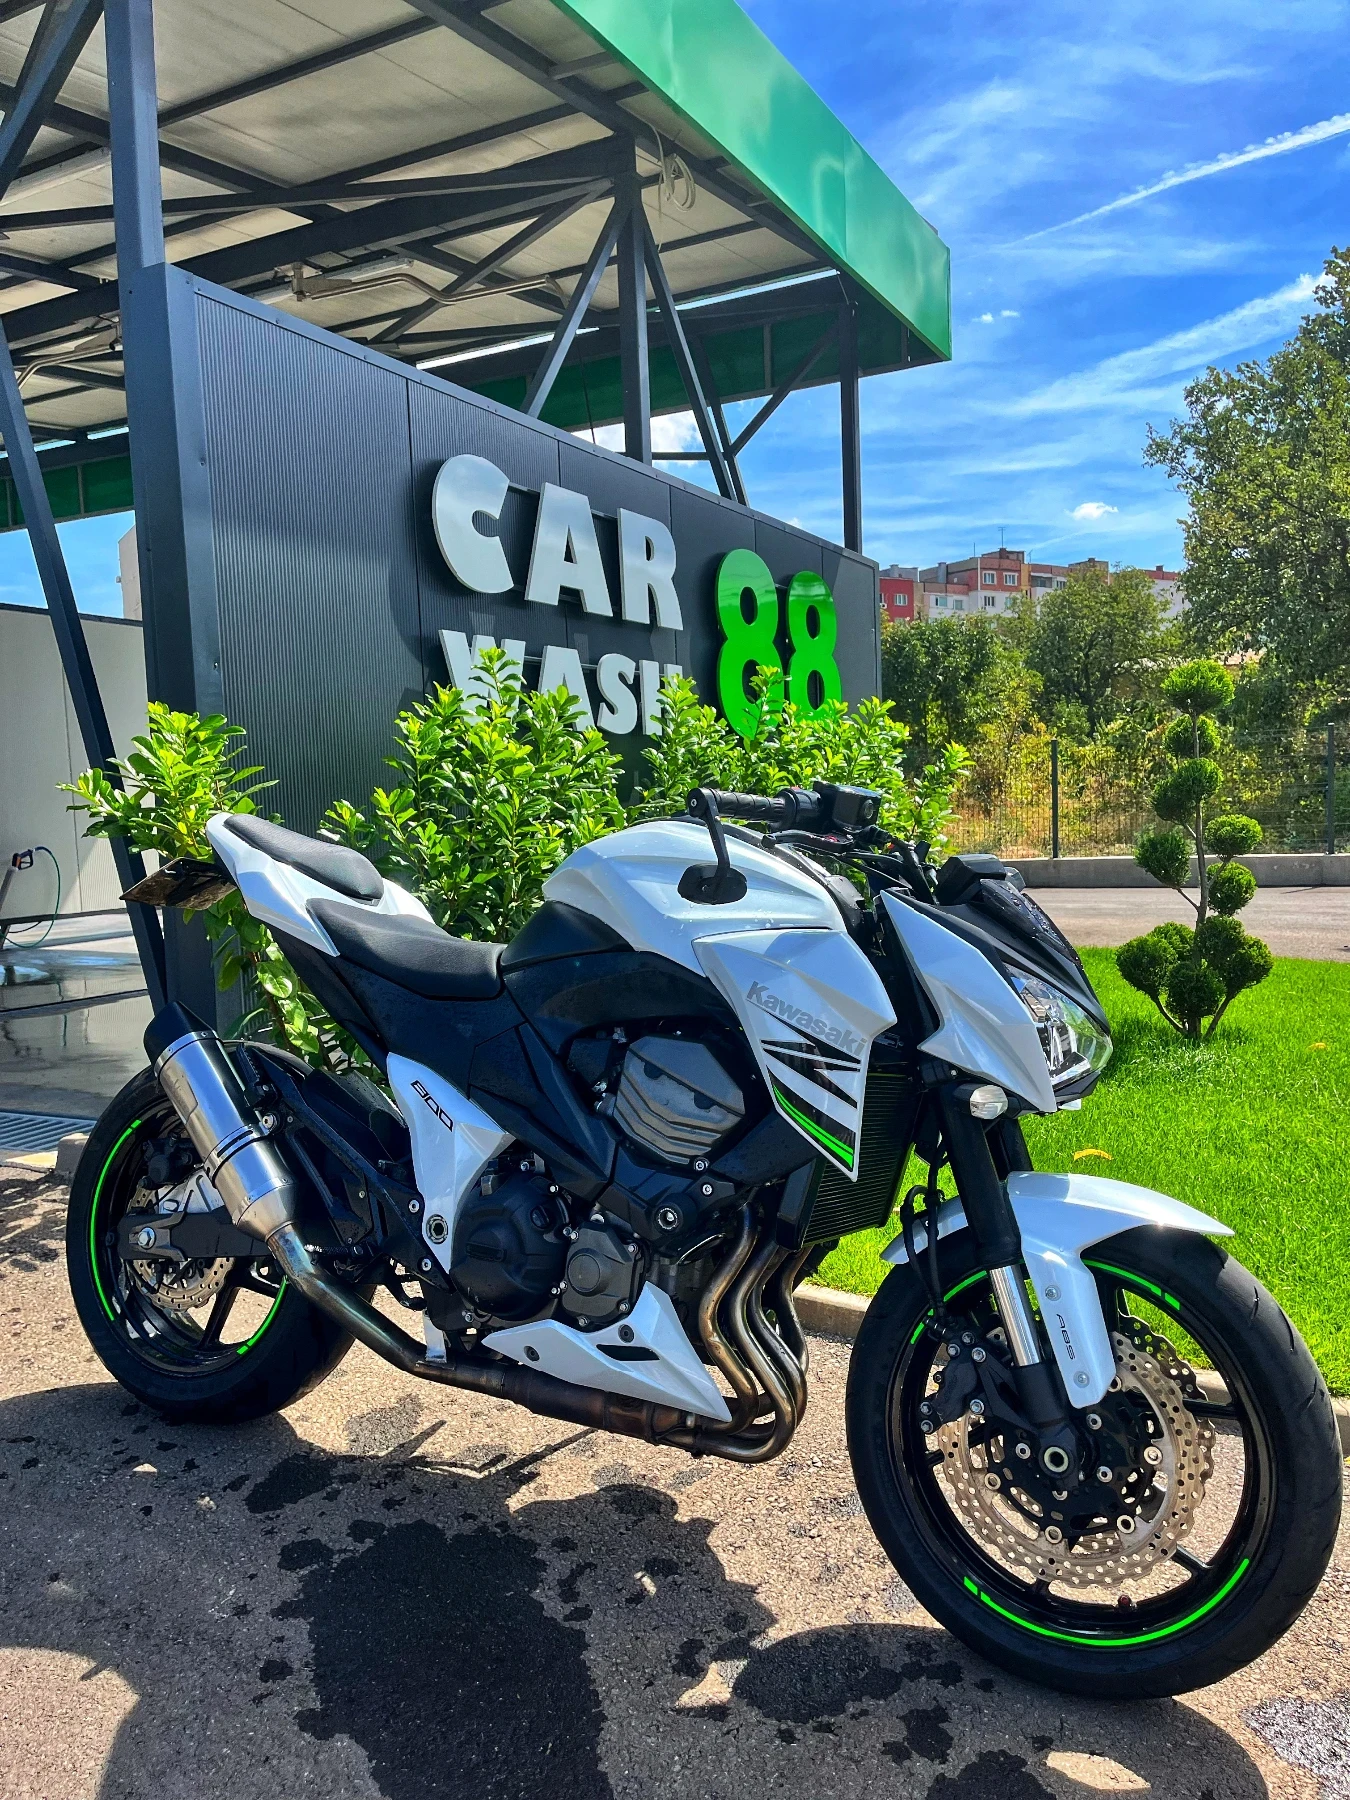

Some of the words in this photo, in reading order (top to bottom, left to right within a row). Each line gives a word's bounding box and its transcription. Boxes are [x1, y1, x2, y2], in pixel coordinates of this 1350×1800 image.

[432, 454, 683, 631] CAR
[715, 548, 842, 741] 88
[746, 980, 868, 1057] Kawasaki
[410, 1080, 454, 1133] 800
[1056, 1313, 1076, 1360] ABS
